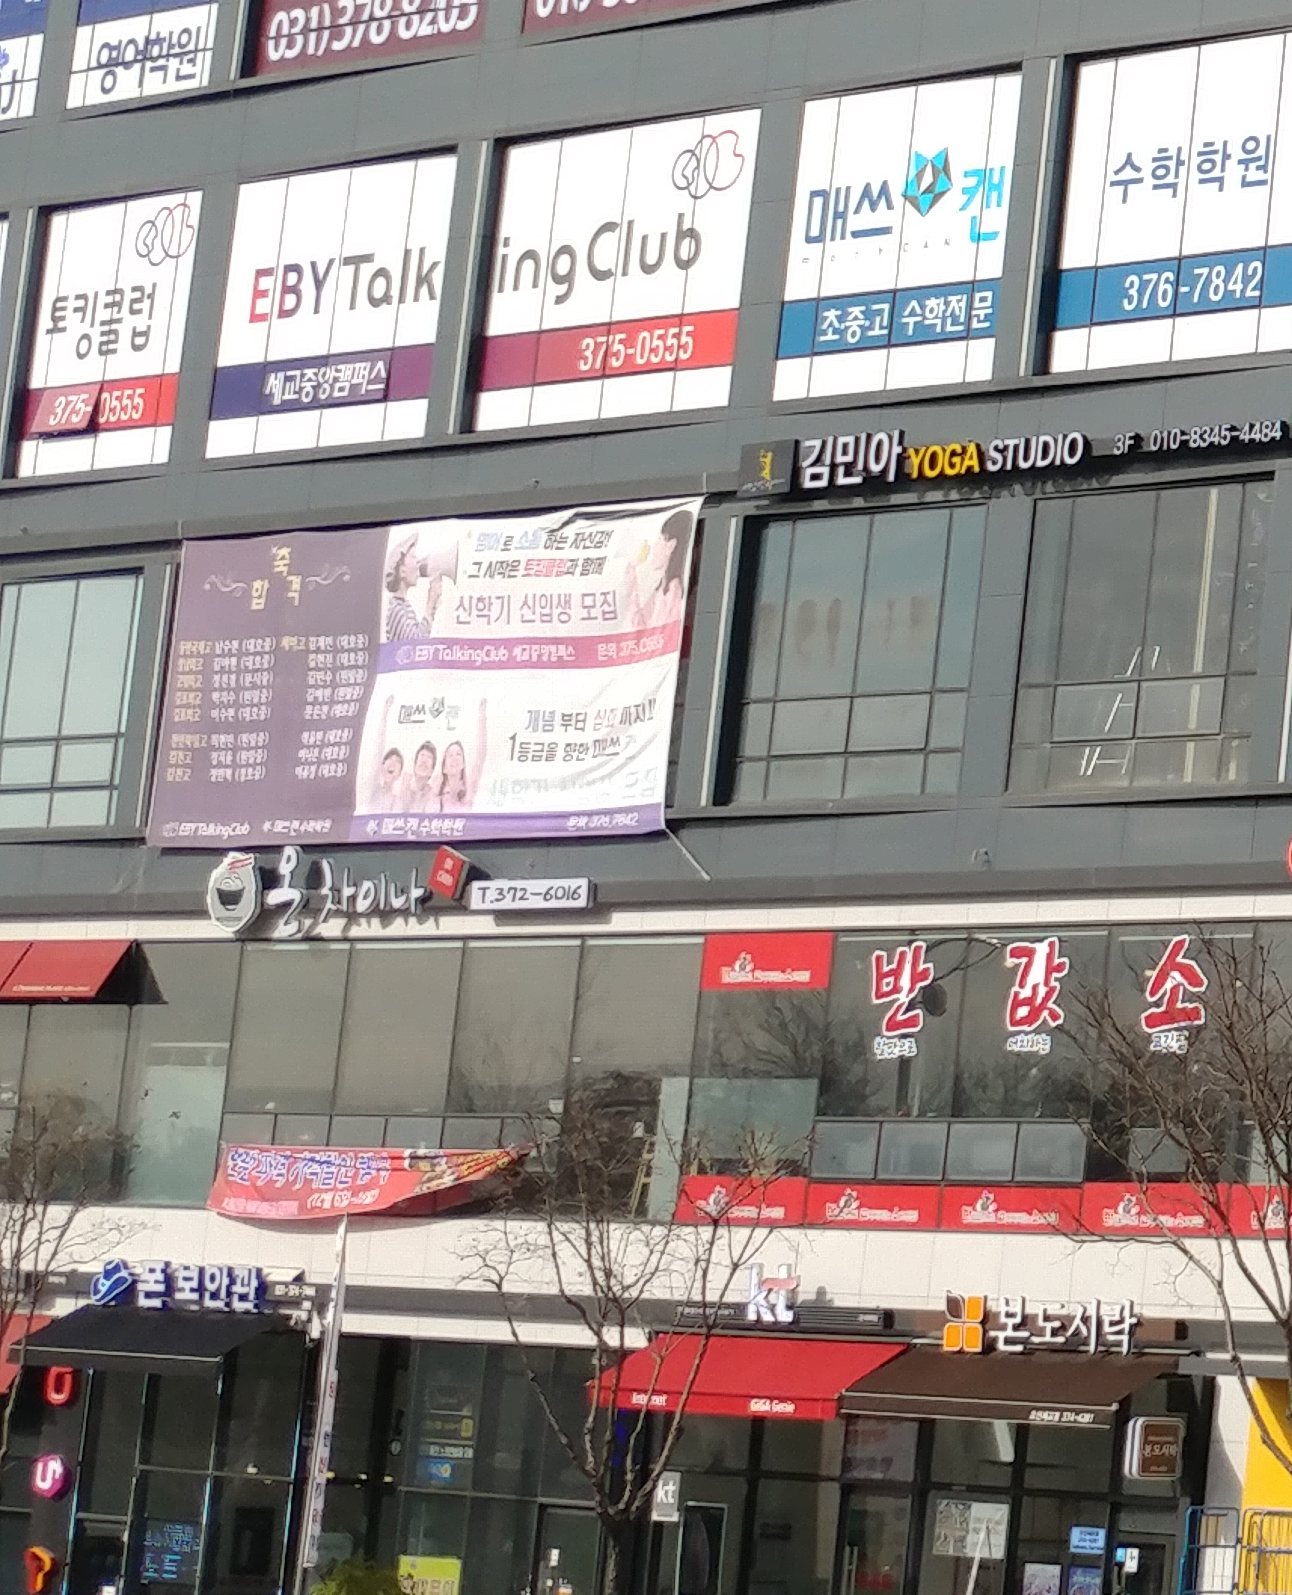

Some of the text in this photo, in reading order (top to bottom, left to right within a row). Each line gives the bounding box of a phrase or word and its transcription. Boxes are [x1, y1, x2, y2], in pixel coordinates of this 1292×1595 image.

[97, 23, 204, 96] 영어학원
[1109, 134, 1272, 204] 수학학원
[1122, 261, 1263, 312] 376-7842
[45, 282, 157, 361] 토킹클럽
[901, 289, 992, 336] 수학전문
[578, 325, 694, 372] 375-0555
[49, 388, 146, 426] 375-0555
[264, 358, 387, 406] 세교중앙캠퍼스
[801, 421, 1284, 490] 김민아 YOGA STUDIO 3F 010-8345-4484
[455, 590, 618, 625] 신학기 신입생 모집
[747, 1262, 799, 1323] kt
[990, 1294, 1139, 1355] 본도시락
[655, 1478, 676, 1505] kt
